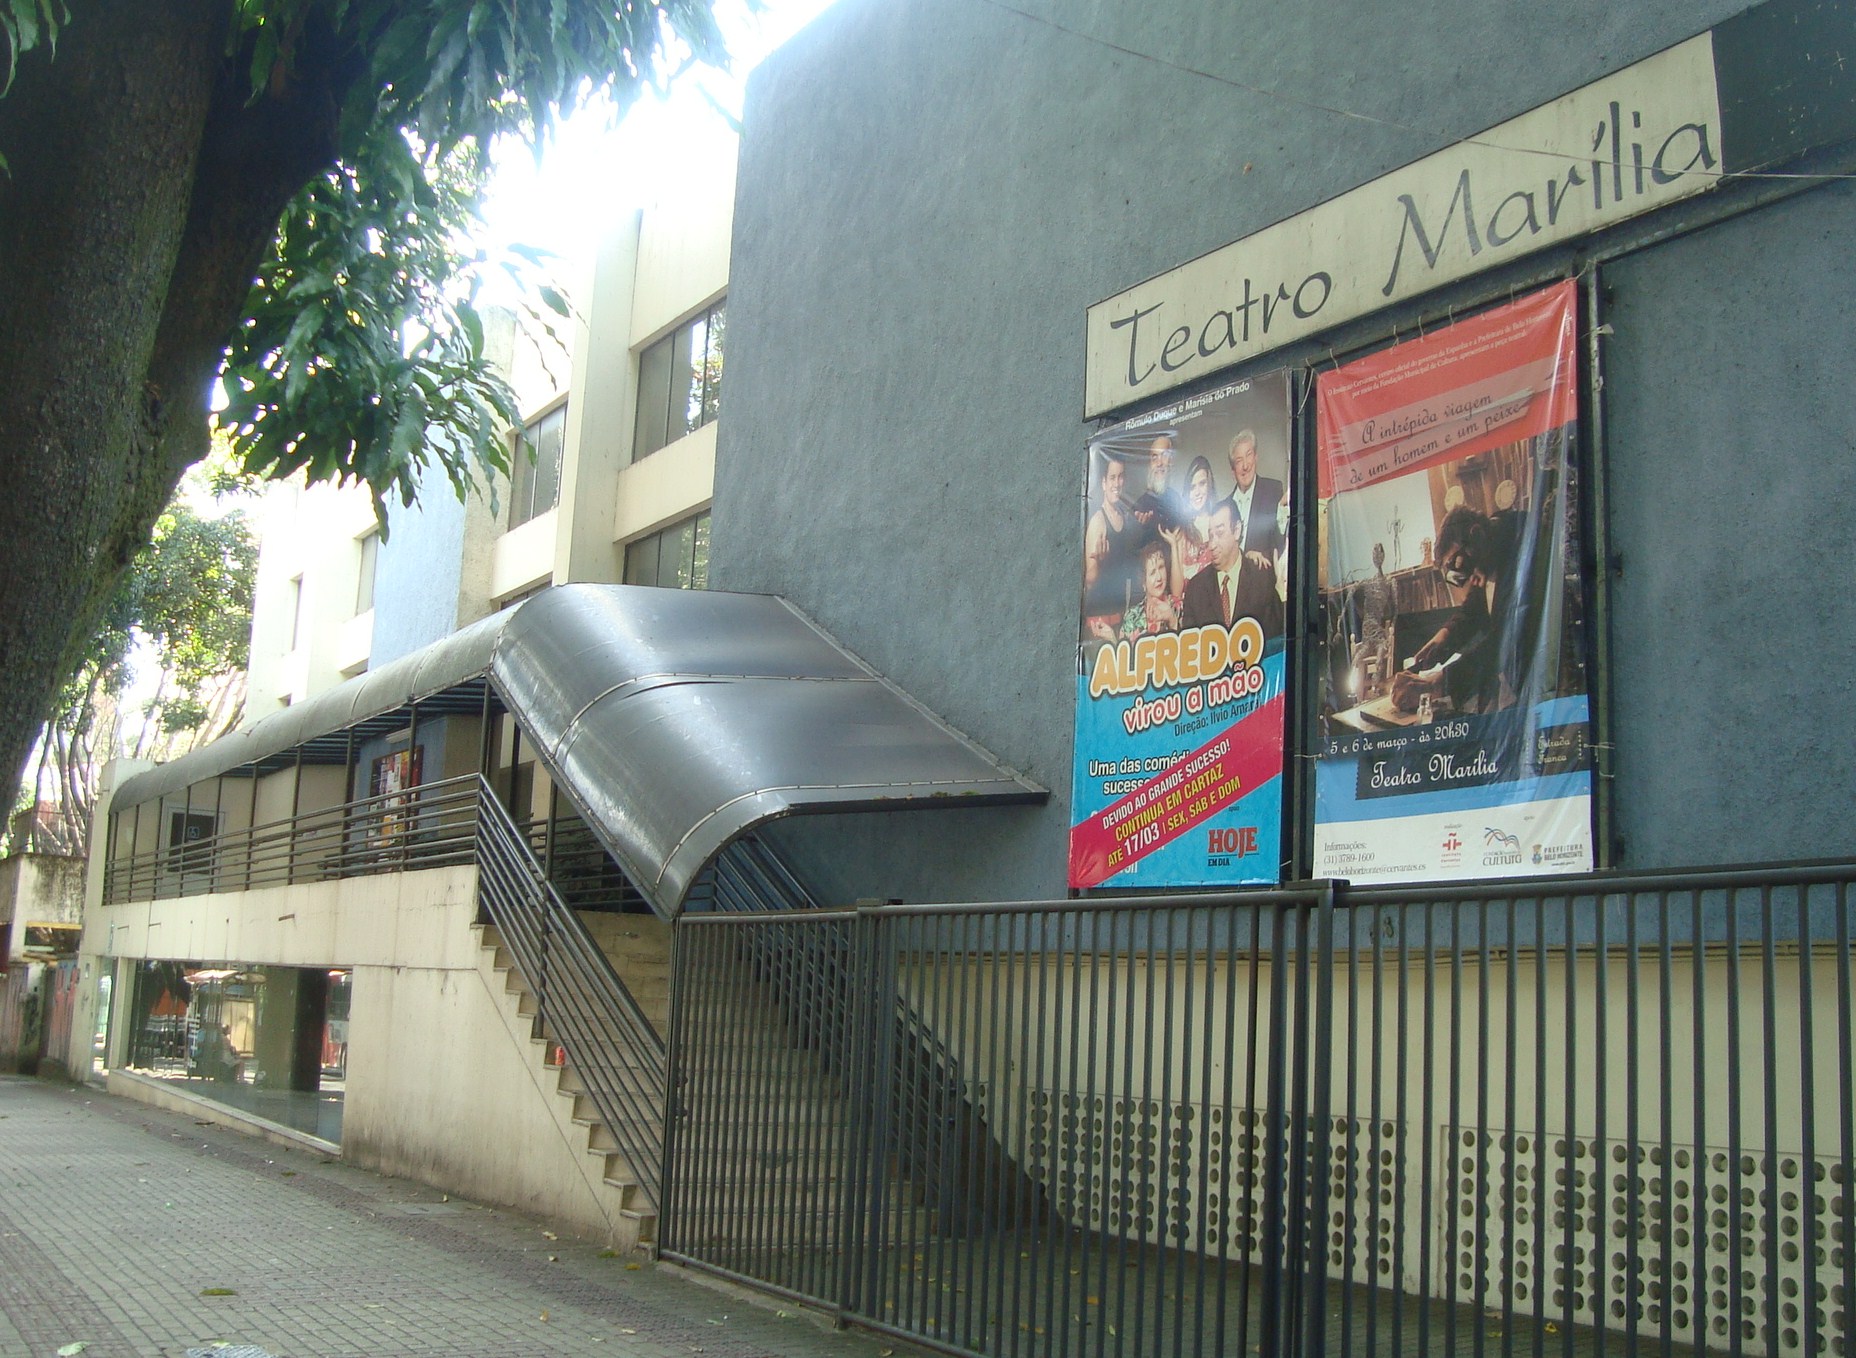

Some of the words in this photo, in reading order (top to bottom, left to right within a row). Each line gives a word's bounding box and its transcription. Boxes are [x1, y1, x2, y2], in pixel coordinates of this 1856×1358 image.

[1110, 271, 1332, 387] Teatro
[1381, 100, 1717, 297] Marília
[1153, 407, 1177, 425] Duque
[1178, 405, 1184, 413] e
[1214, 390, 1225, 401] do
[1226, 382, 1250, 399] Prado
[1169, 409, 1203, 427] apresentam
[1362, 420, 1376, 444] A
[1380, 409, 1437, 440] intrépida
[1444, 395, 1492, 421] viagem
[1350, 468, 1364, 485] de
[1369, 462, 1388, 477] um
[1393, 445, 1438, 467] homem
[1444, 434, 1452, 444] e
[1457, 422, 1479, 438] um
[1484, 401, 1526, 436] peixe
[1091, 617, 1264, 697] ALFREDO
[1124, 694, 1182, 734] virou
[1185, 686, 1204, 712] a
[1208, 661, 1264, 706] mão
[1174, 717, 1209, 737] Direção:
[1330, 741, 1338, 754] 5
[1342, 745, 1348, 753] e
[1352, 739, 1359, 752] 6
[1363, 738, 1373, 751] de
[1377, 737, 1407, 751] março
[1419, 730, 1431, 743] às
[1434, 720, 1469, 741] 20h30
[1089, 760, 1116, 777] Uma
[1120, 756, 1141, 774] das
[1102, 803, 1134, 829] DEVIDO
[1134, 793, 1147, 813] AO
[1148, 772, 1184, 801] GRANDE
[1186, 738, 1231, 778] SUCESSO!
[1370, 761, 1421, 788] Teatro
[1428, 750, 1498, 781] Marília
[1115, 806, 1165, 842] CONTINUA
[1166, 792, 1183, 811] EM
[1184, 762, 1225, 799] CARTAZ
[1107, 845, 1124, 868] ATÉ
[1123, 823, 1160, 856] 17/03
[1168, 811, 1189, 832] SEX,
[1190, 798, 1208, 818] SÁB
[1210, 791, 1217, 804] E
[1219, 780, 1241, 801] DOM
[1208, 827, 1258, 858] HOJE
[1218, 858, 1231, 866] DIA
[1324, 840, 1367, 852] Informações:
[1324, 855, 1338, 865] (31)
